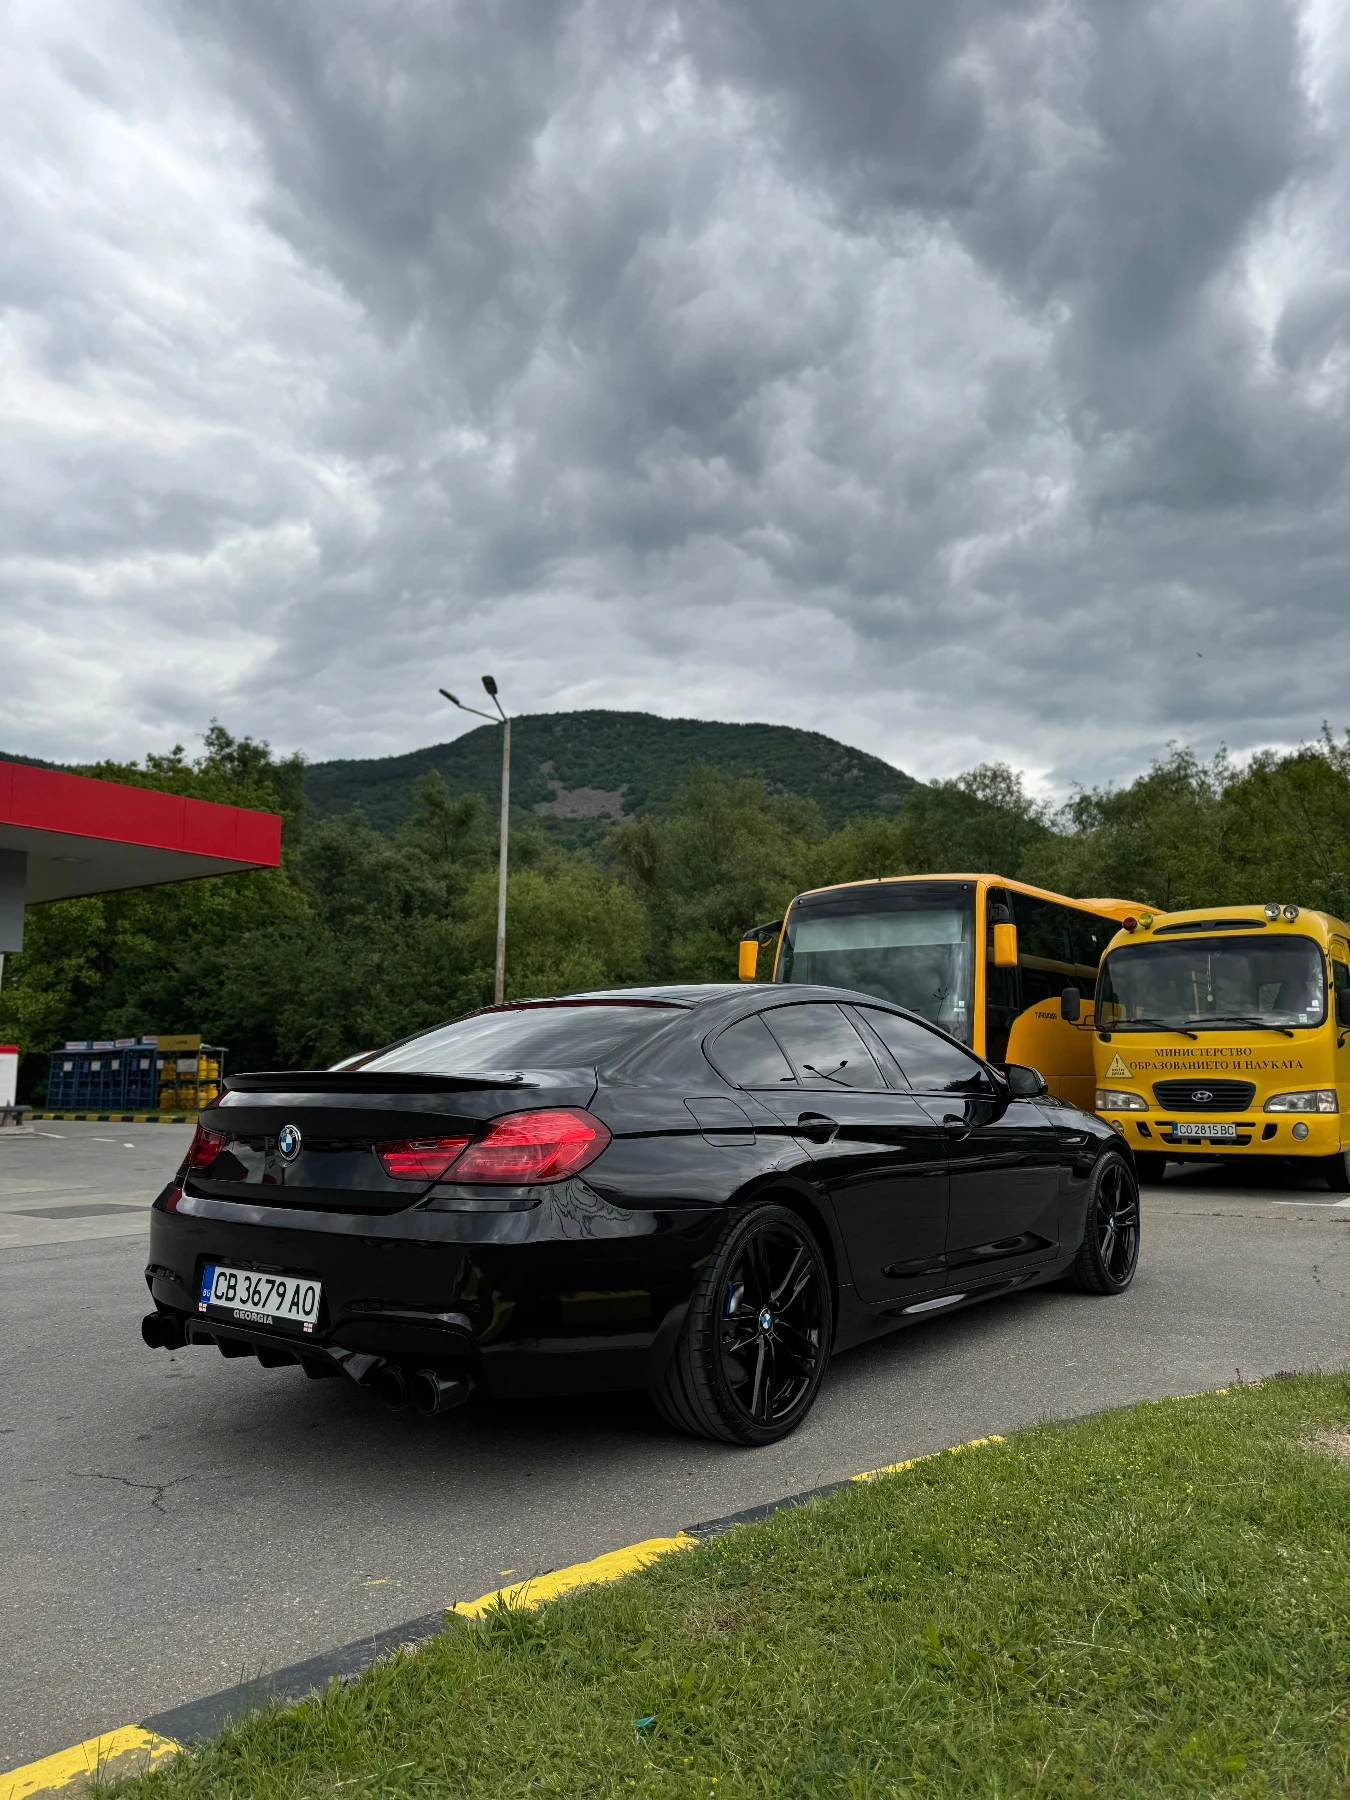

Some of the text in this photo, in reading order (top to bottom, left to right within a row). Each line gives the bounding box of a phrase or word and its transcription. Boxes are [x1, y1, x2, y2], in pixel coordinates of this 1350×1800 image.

[1154, 1047, 1252, 1057] МИНИСТЕРСТВО
[1129, 1060, 1304, 1070] ОБРАЗОВАНИЕТО И НАУКАТА
[1194, 1125, 1219, 1135] 2815
[214, 1271, 238, 1302] CB
[239, 1276, 287, 1311] 3679
[233, 1309, 273, 1325] GEORGIA
